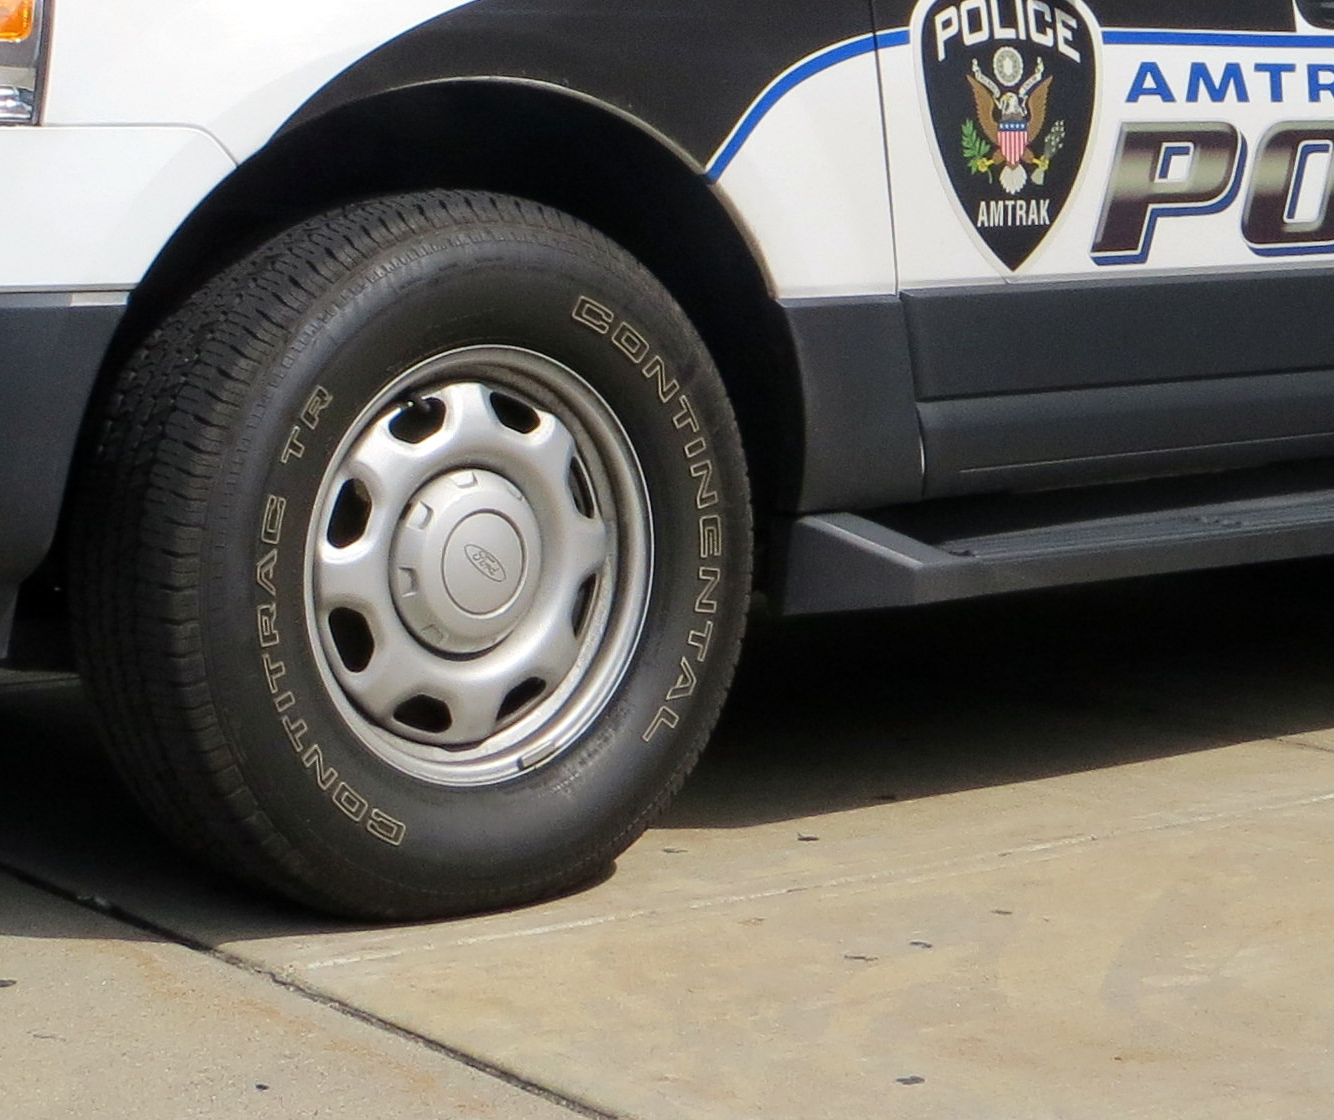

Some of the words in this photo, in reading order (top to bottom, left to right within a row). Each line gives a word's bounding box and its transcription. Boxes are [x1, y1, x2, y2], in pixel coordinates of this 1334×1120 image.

[976, 198, 1051, 228] AMTRAK
[280, 384, 333, 465] TR
[570, 294, 722, 744] CONTINENTAL
[256, 493, 407, 847] CONTITRAC
